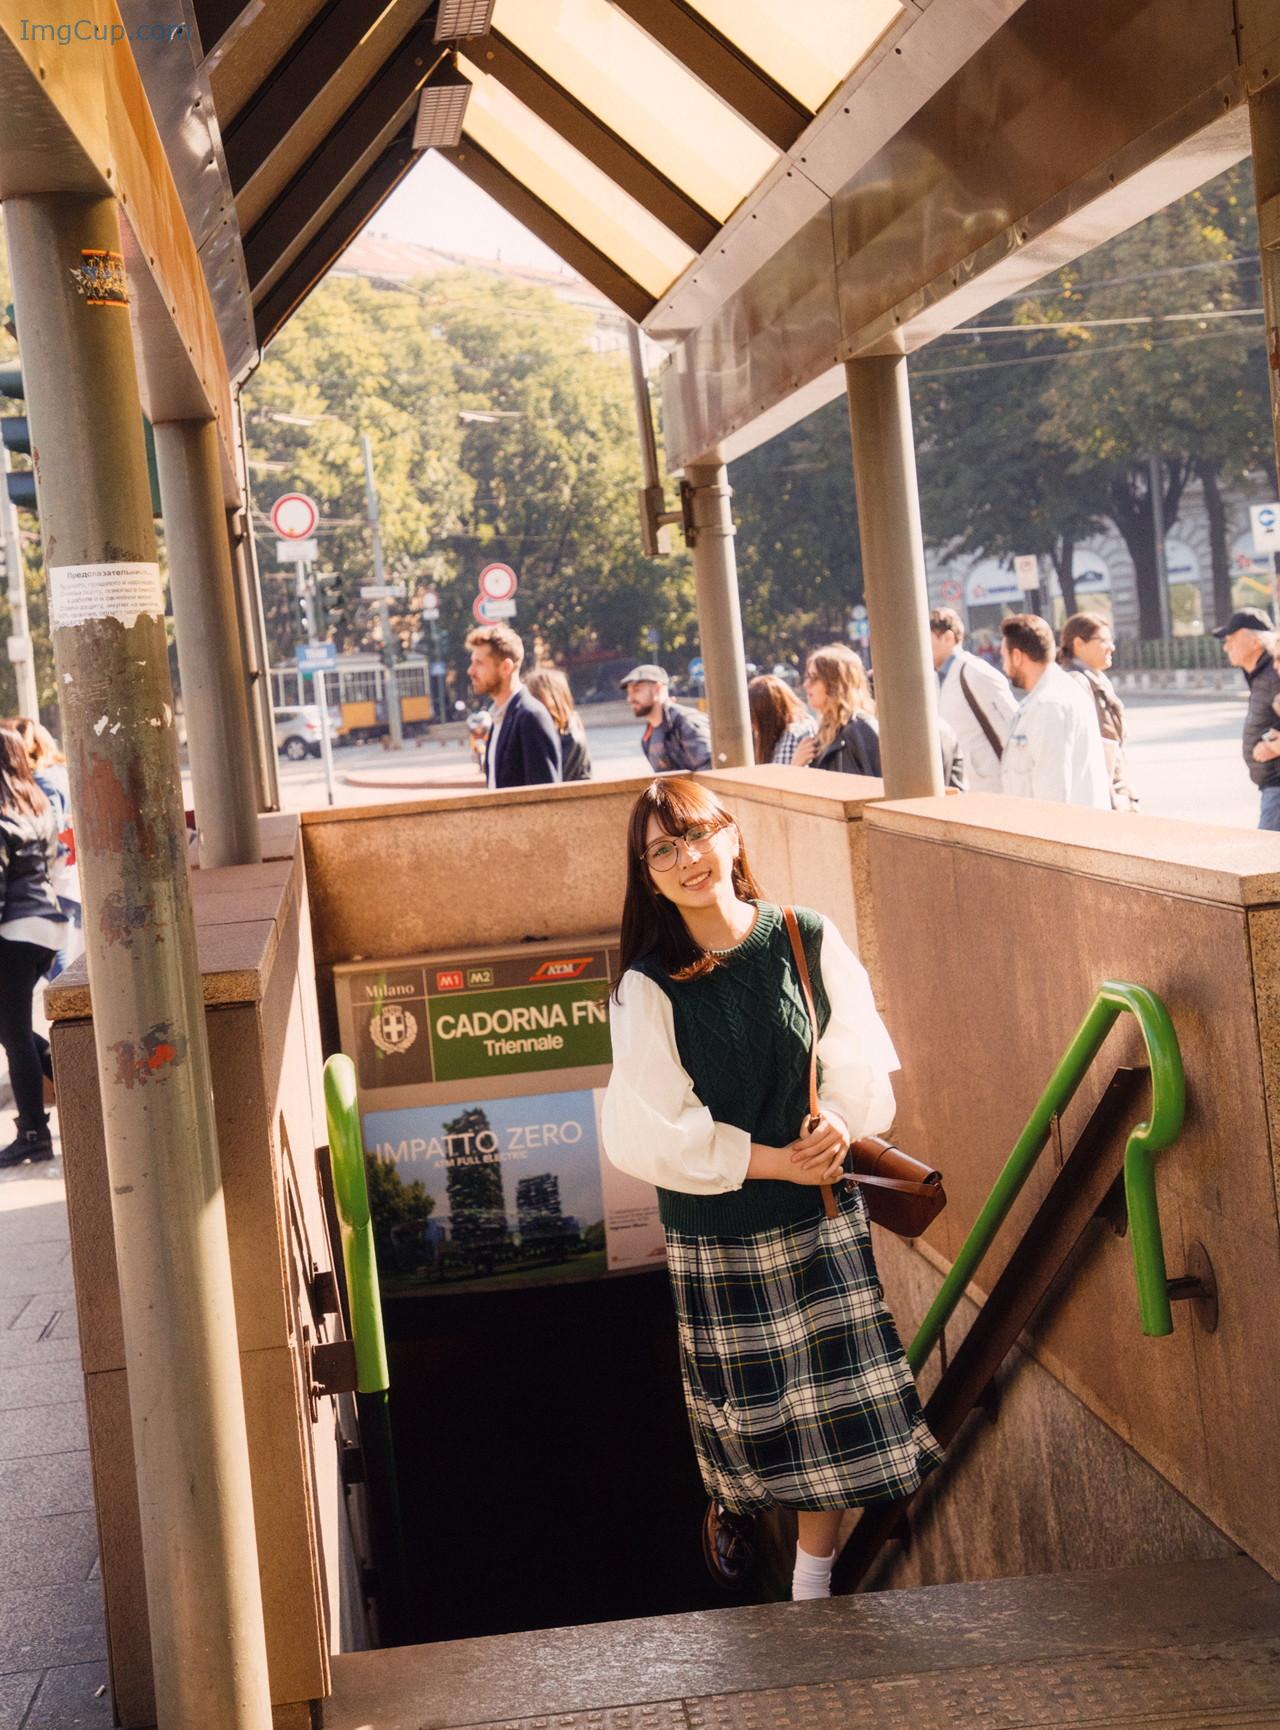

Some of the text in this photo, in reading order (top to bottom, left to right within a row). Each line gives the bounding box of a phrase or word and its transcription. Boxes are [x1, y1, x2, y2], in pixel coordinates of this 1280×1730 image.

[547, 963, 574, 975] ATM
[439, 974, 460, 987] M1
[470, 971, 491, 983] M2
[365, 983, 415, 998] Milano
[436, 1003, 567, 1040] CADORNA
[483, 1033, 564, 1056] Triennale
[375, 1120, 583, 1164] IMPATTO ZERO
[456, 1156, 480, 1167] FULL
[482, 1151, 528, 1163] ELECTRIC
